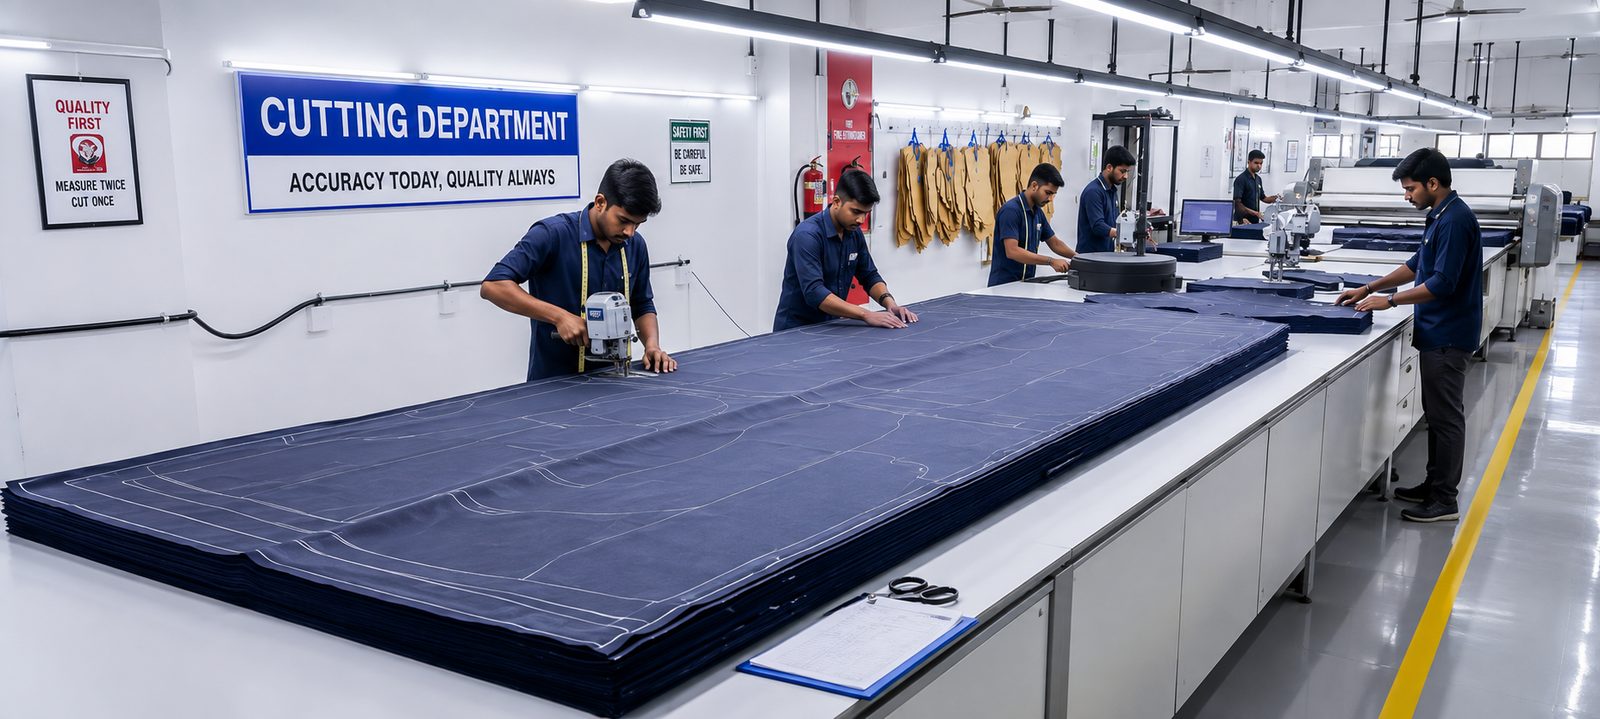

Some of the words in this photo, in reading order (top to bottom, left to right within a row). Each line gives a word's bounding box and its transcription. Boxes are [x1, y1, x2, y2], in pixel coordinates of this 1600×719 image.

[55, 99, 110, 114] QUALITY
[68, 117, 101, 130] FIRST
[260, 96, 408, 139] CUTTING
[417, 104, 568, 141] DEPARTMENT
[674, 148, 682, 159] BE
[680, 164, 687, 175] BE
[55, 180, 98, 192] MEASURE
[100, 179, 126, 190] TWICE
[289, 171, 385, 193] ACCURACY
[389, 170, 443, 191] TODAY,
[446, 169, 503, 188] QUALITY
[507, 168, 556, 186] ALWAYS
[71, 196, 89, 208] CUT
[91, 195, 114, 206] ONCE
